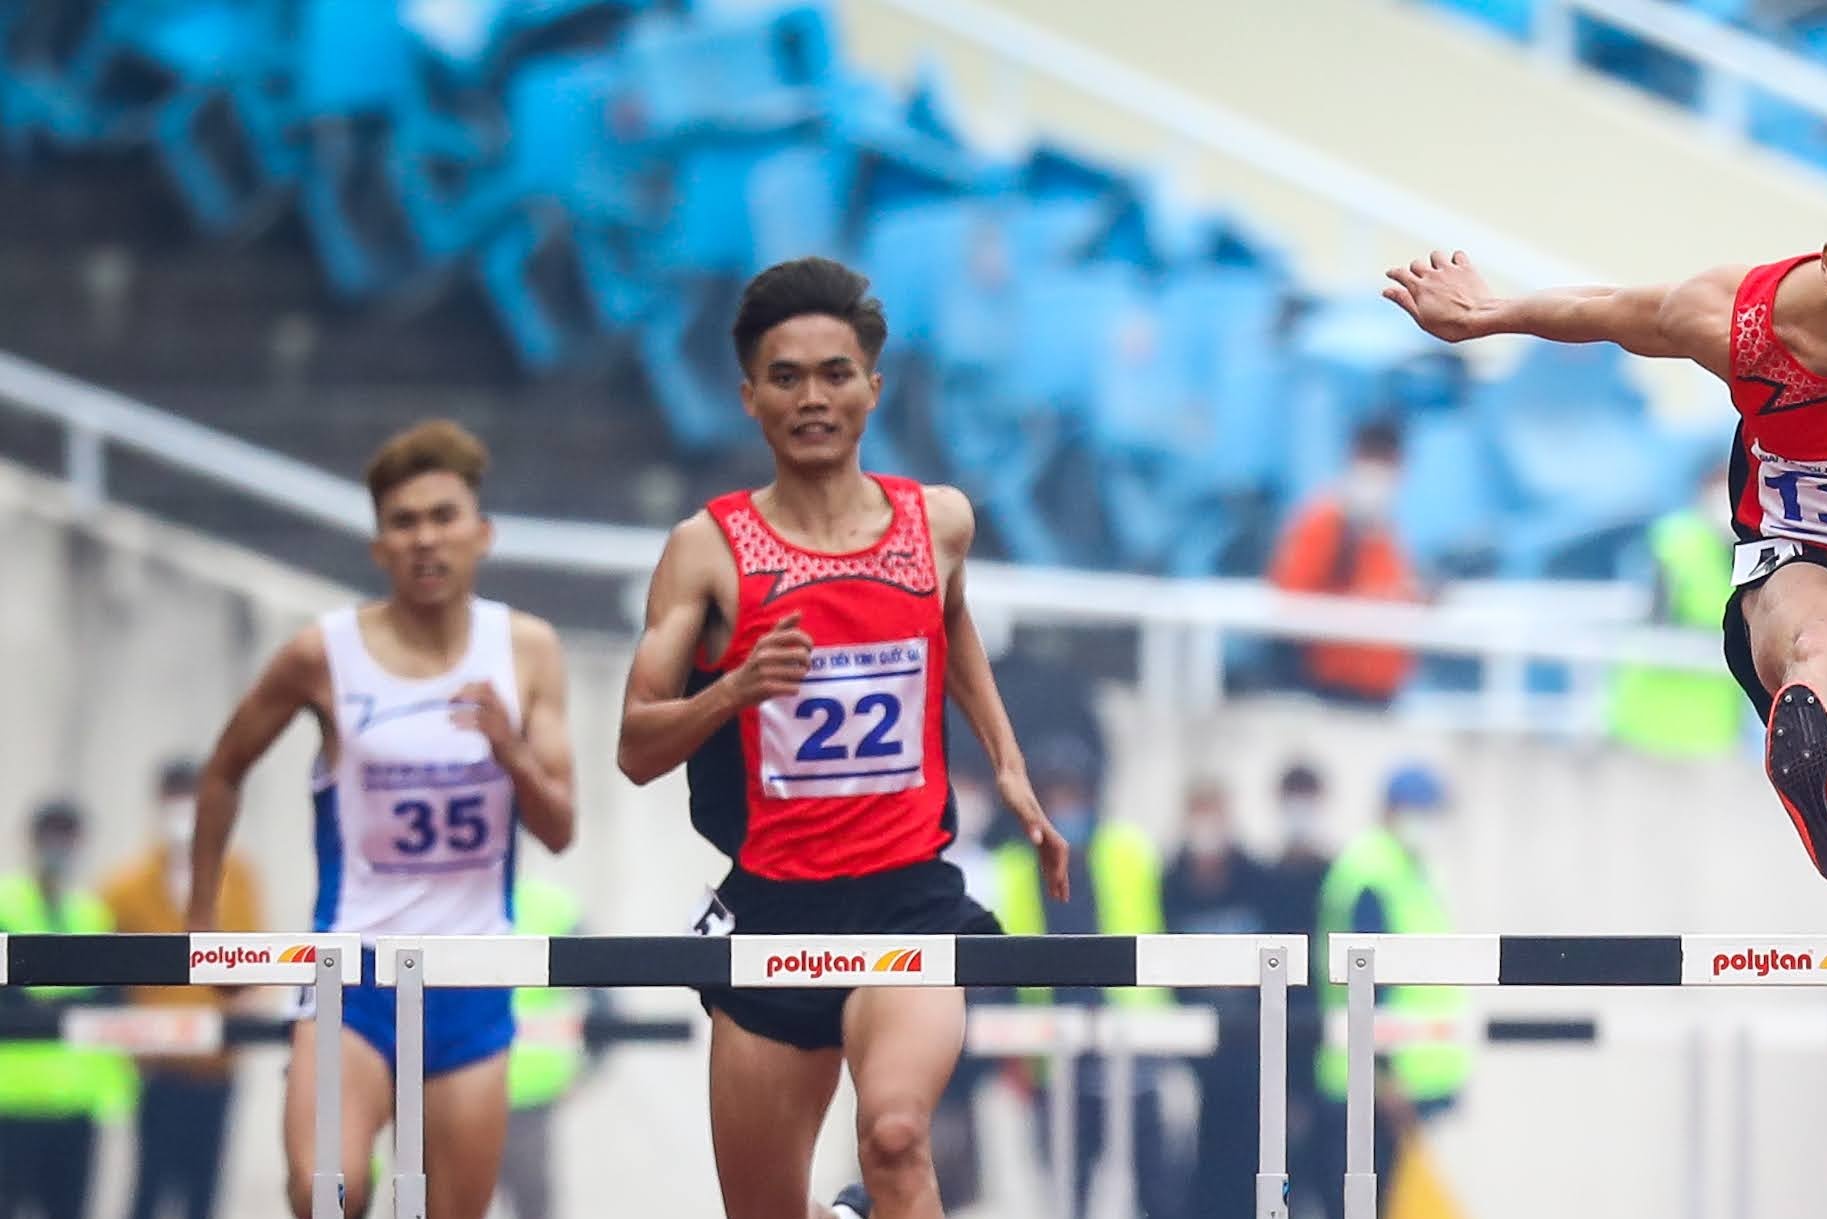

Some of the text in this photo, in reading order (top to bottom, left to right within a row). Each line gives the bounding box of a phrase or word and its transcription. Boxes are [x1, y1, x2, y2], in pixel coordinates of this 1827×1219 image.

[794, 692, 904, 763] 22
[391, 793, 490, 856] 35
[190, 946, 271, 969] polytan
[766, 950, 866, 979] polytan
[1713, 948, 1813, 977] polytan
